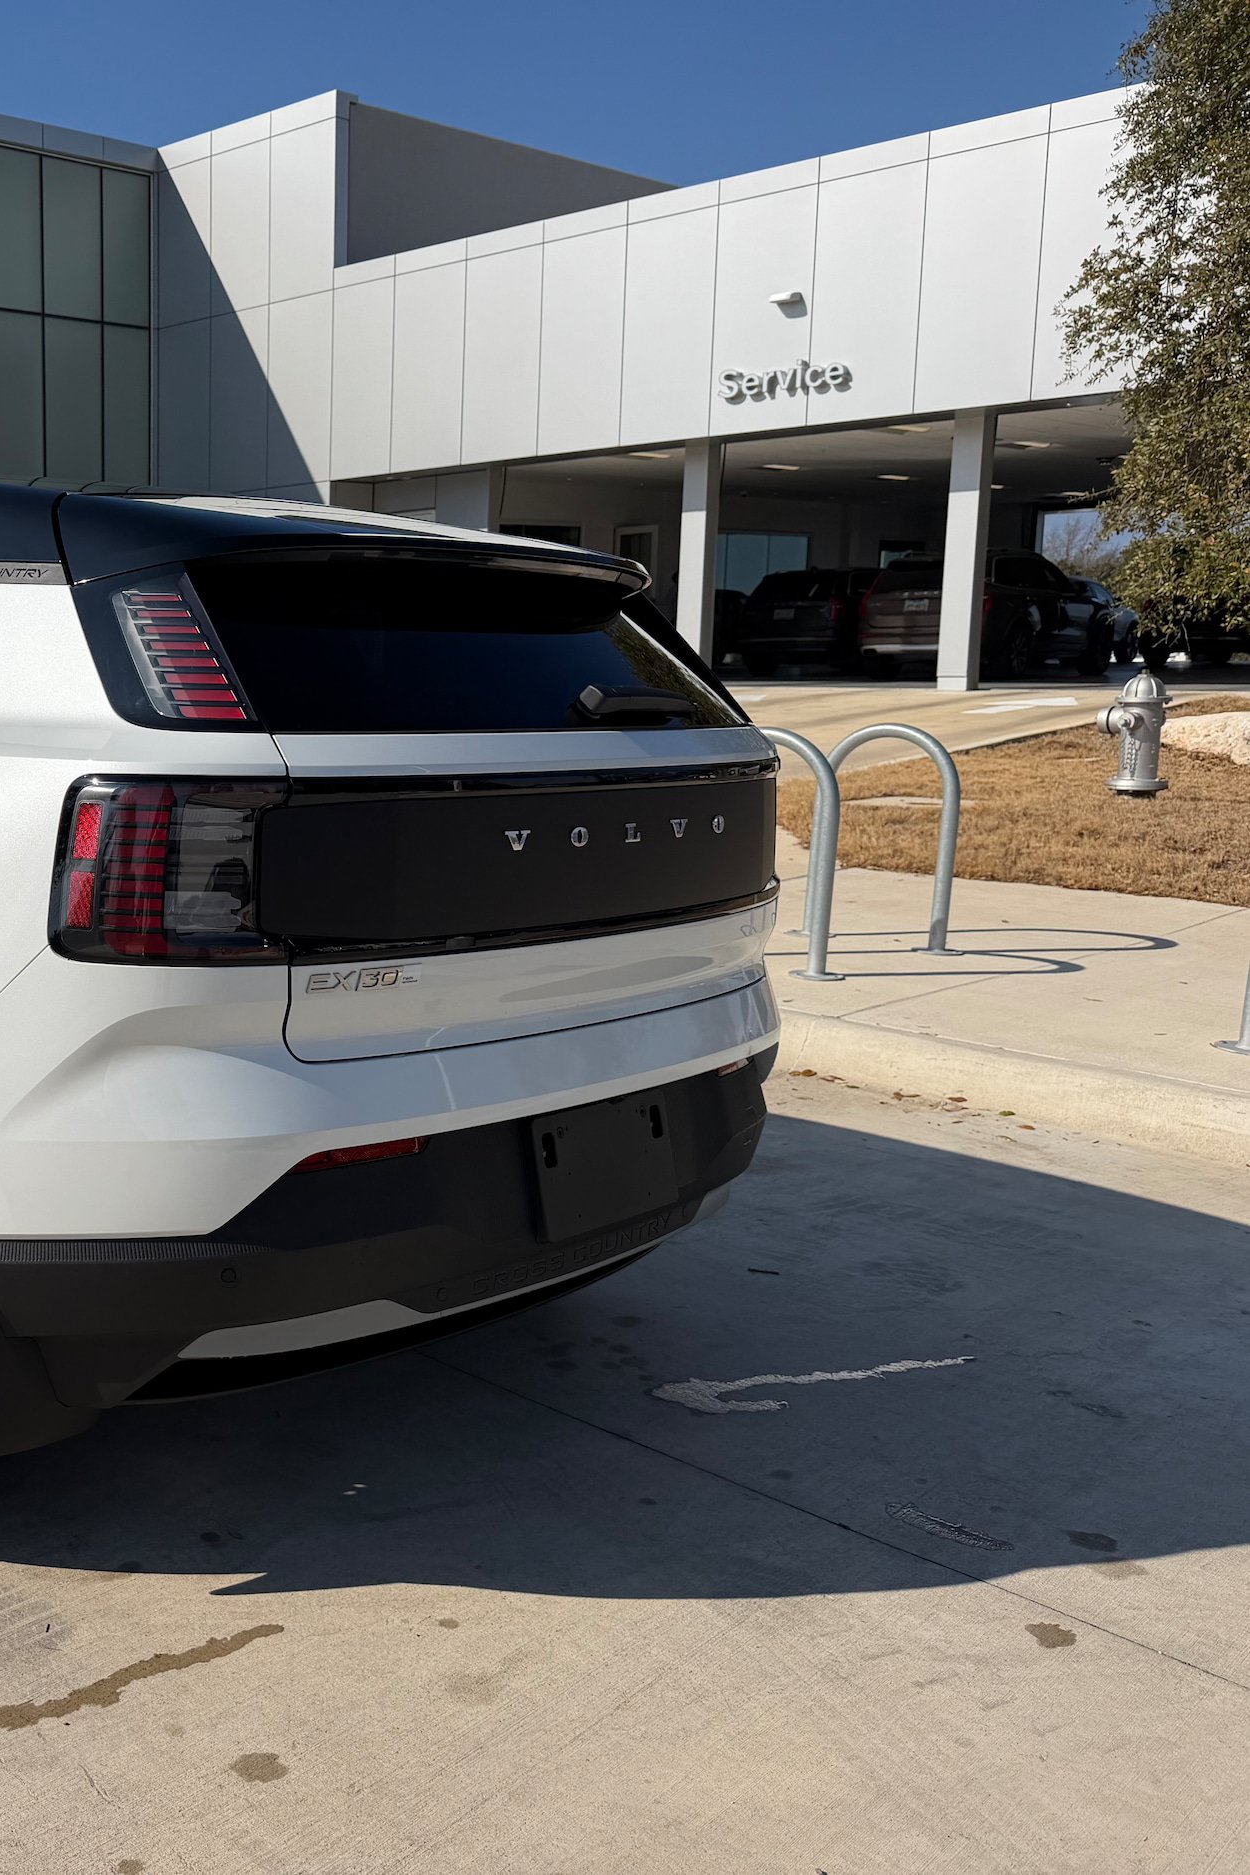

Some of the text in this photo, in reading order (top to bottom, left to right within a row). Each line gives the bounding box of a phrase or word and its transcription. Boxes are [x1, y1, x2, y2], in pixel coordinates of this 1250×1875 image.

[718, 359, 847, 399] Service
[504, 814, 726, 851] VOLVO
[471, 1213, 672, 1296] CROSS COUNTRY
